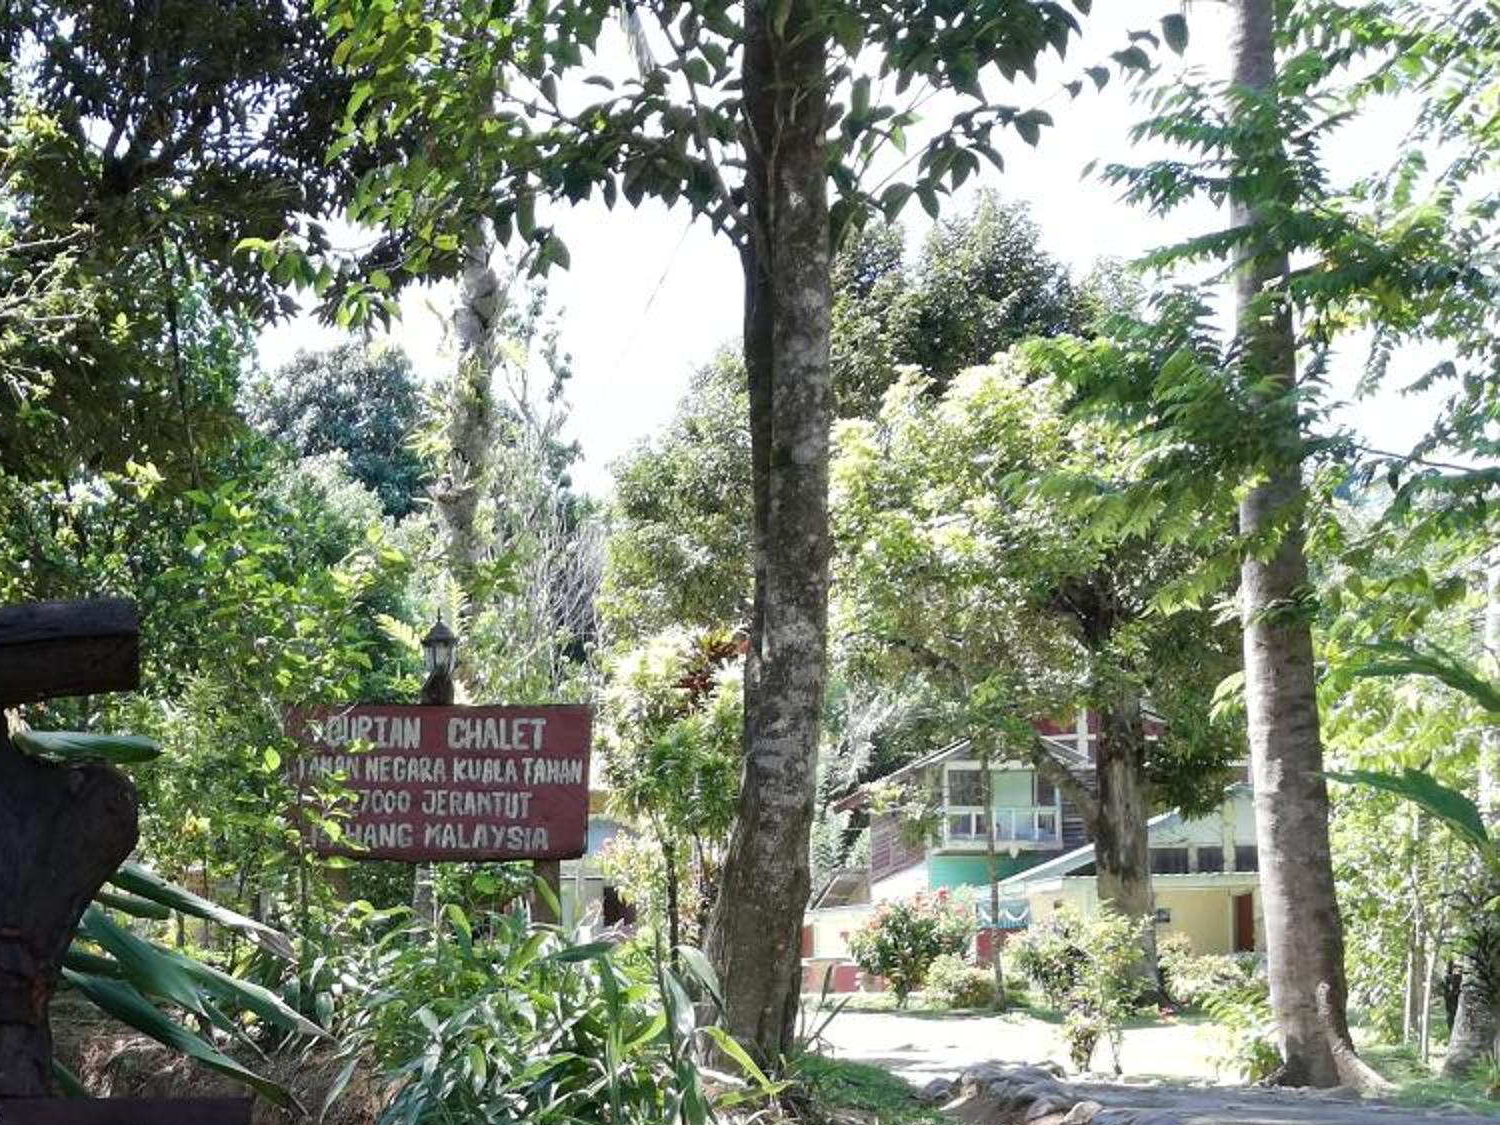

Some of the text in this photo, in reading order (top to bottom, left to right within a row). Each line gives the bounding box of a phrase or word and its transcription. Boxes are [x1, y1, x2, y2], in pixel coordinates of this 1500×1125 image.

[447, 717, 547, 750] CHALET
[365, 756, 446, 783] NEGARA
[453, 757, 515, 784] KUALA
[521, 757, 582, 784] TAHAN
[421, 789, 532, 818] JERANTUT
[423, 823, 549, 851] MALAYSIA
